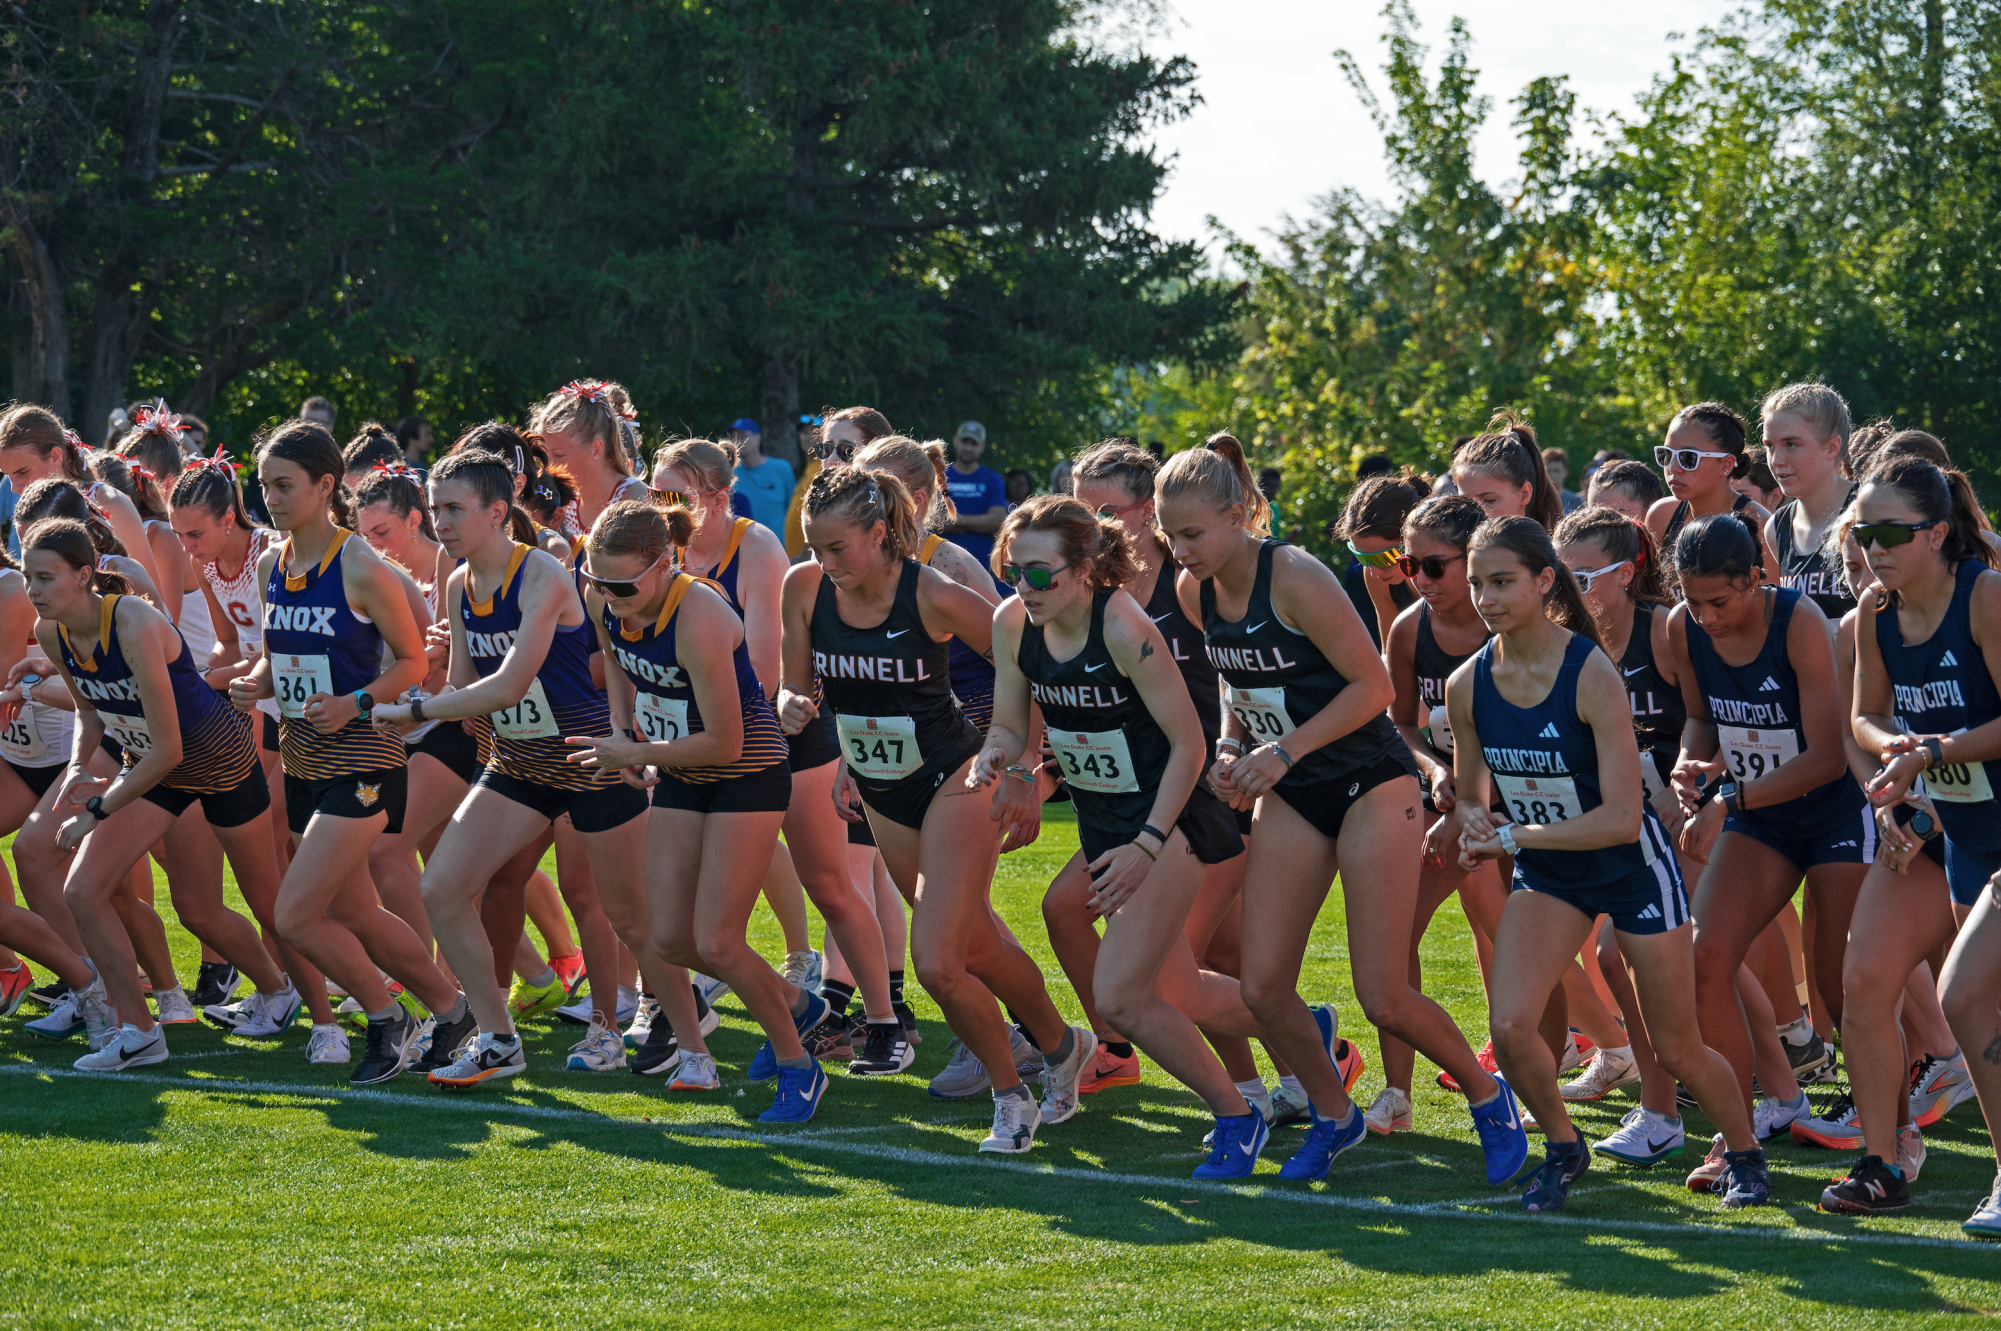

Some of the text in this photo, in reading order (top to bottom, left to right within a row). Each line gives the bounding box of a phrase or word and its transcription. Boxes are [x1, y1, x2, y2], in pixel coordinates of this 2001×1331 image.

[228, 601, 255, 627] C
[264, 602, 336, 636] KNOX
[466, 630, 518, 657] KNO
[610, 641, 687, 688] NOX
[812, 649, 930, 683] RINNELL
[279, 676, 317, 702] 361
[1234, 707, 1283, 736] 330
[1708, 695, 1789, 725] PRINCIPIA
[114, 728, 152, 749] 363
[850, 738, 903, 764] 347
[1063, 751, 1120, 778] 343
[1484, 747, 1569, 773] PRINCIPIA
[1731, 750, 1780, 779] 391
[1512, 800, 1568, 825] 383
